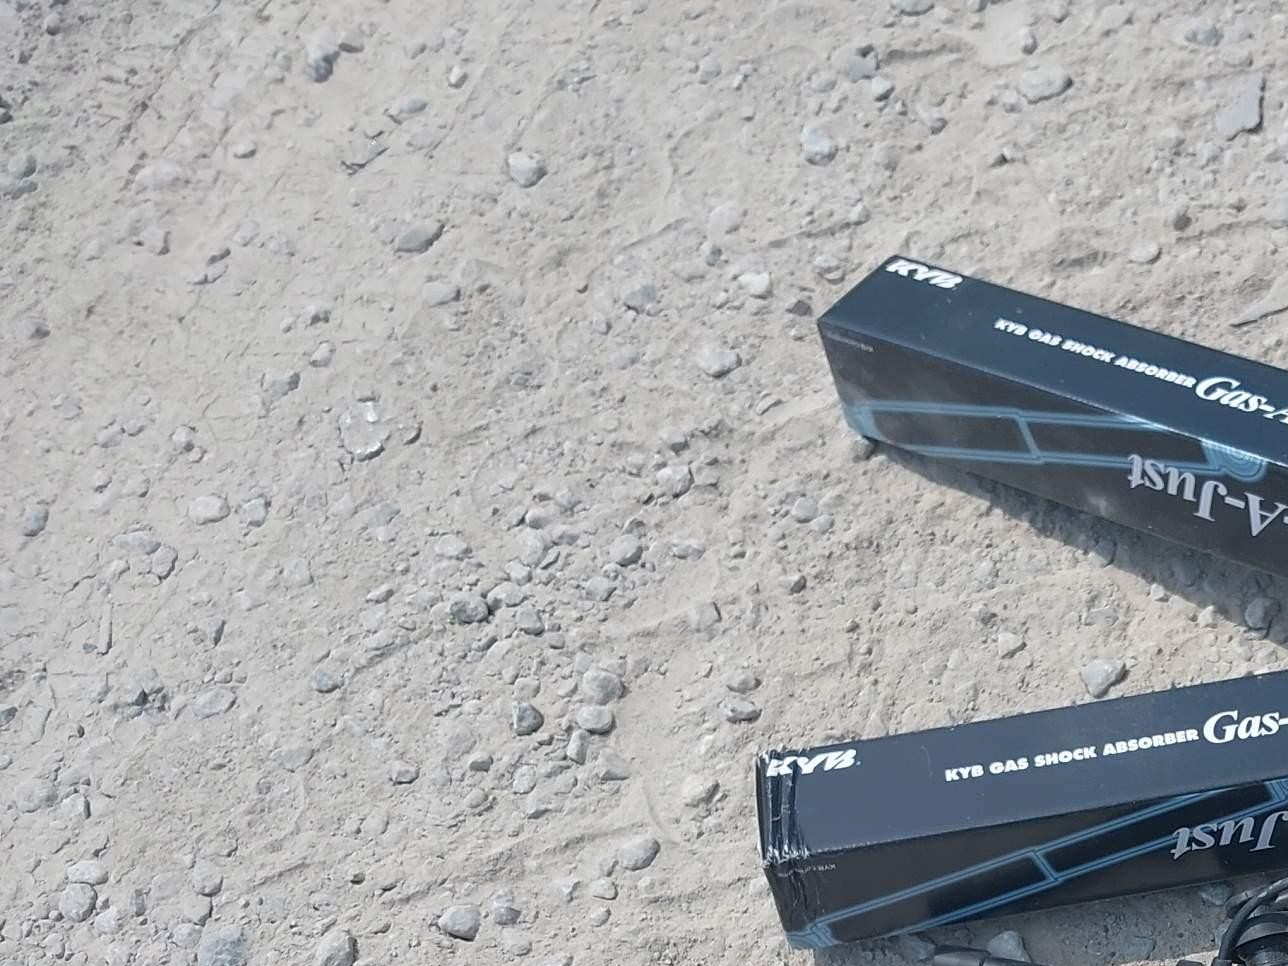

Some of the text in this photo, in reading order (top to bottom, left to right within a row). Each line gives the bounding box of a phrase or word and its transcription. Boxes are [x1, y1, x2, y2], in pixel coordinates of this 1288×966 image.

[886, 258, 963, 289] KYB
[994, 318, 1028, 336] KYB
[1028, 329, 1063, 347] GAS
[1061, 340, 1116, 363] SHOCK
[1113, 356, 1198, 388] ABSORBER
[766, 749, 857, 777] KYB
[944, 764, 984, 782] KYB
[989, 757, 1029, 775] GAS
[1034, 745, 1097, 768] SHOCK
[1102, 728, 1200, 757] ABSORBER
